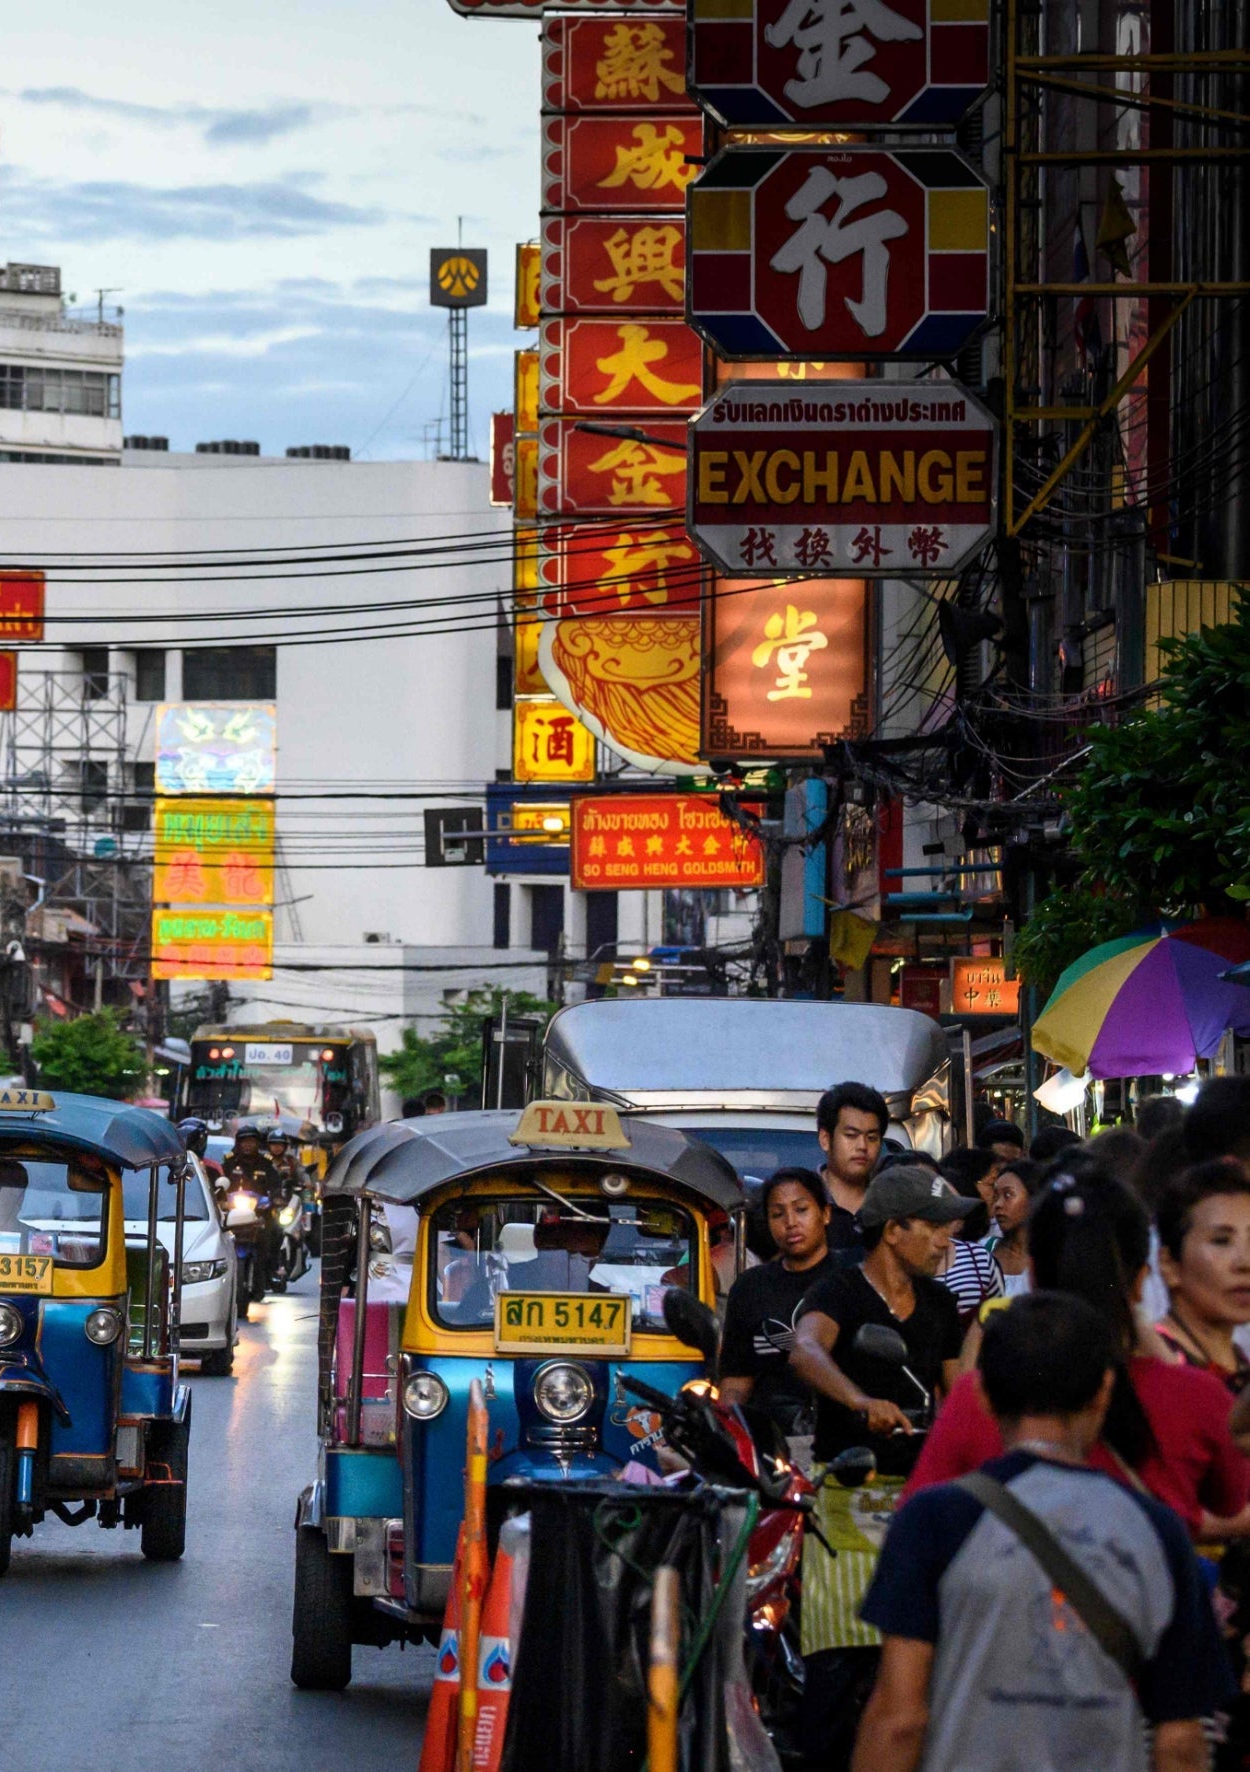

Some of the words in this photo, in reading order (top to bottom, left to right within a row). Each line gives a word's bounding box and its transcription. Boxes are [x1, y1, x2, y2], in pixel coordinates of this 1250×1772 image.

[769, 165, 910, 338] 行
[713, 398, 966, 424] รับแลกเงินตราต่างประเทศ
[699, 450, 987, 504] EXCHANGE
[740, 526, 949, 567] 找換外幣
[583, 864, 600, 877] SO
[605, 864, 639, 877] SENG
[644, 863, 678, 876] HENG
[535, 1107, 606, 1135] TAXI
[0, 1257, 49, 1278] 3157
[555, 1302, 621, 1329] 5147
